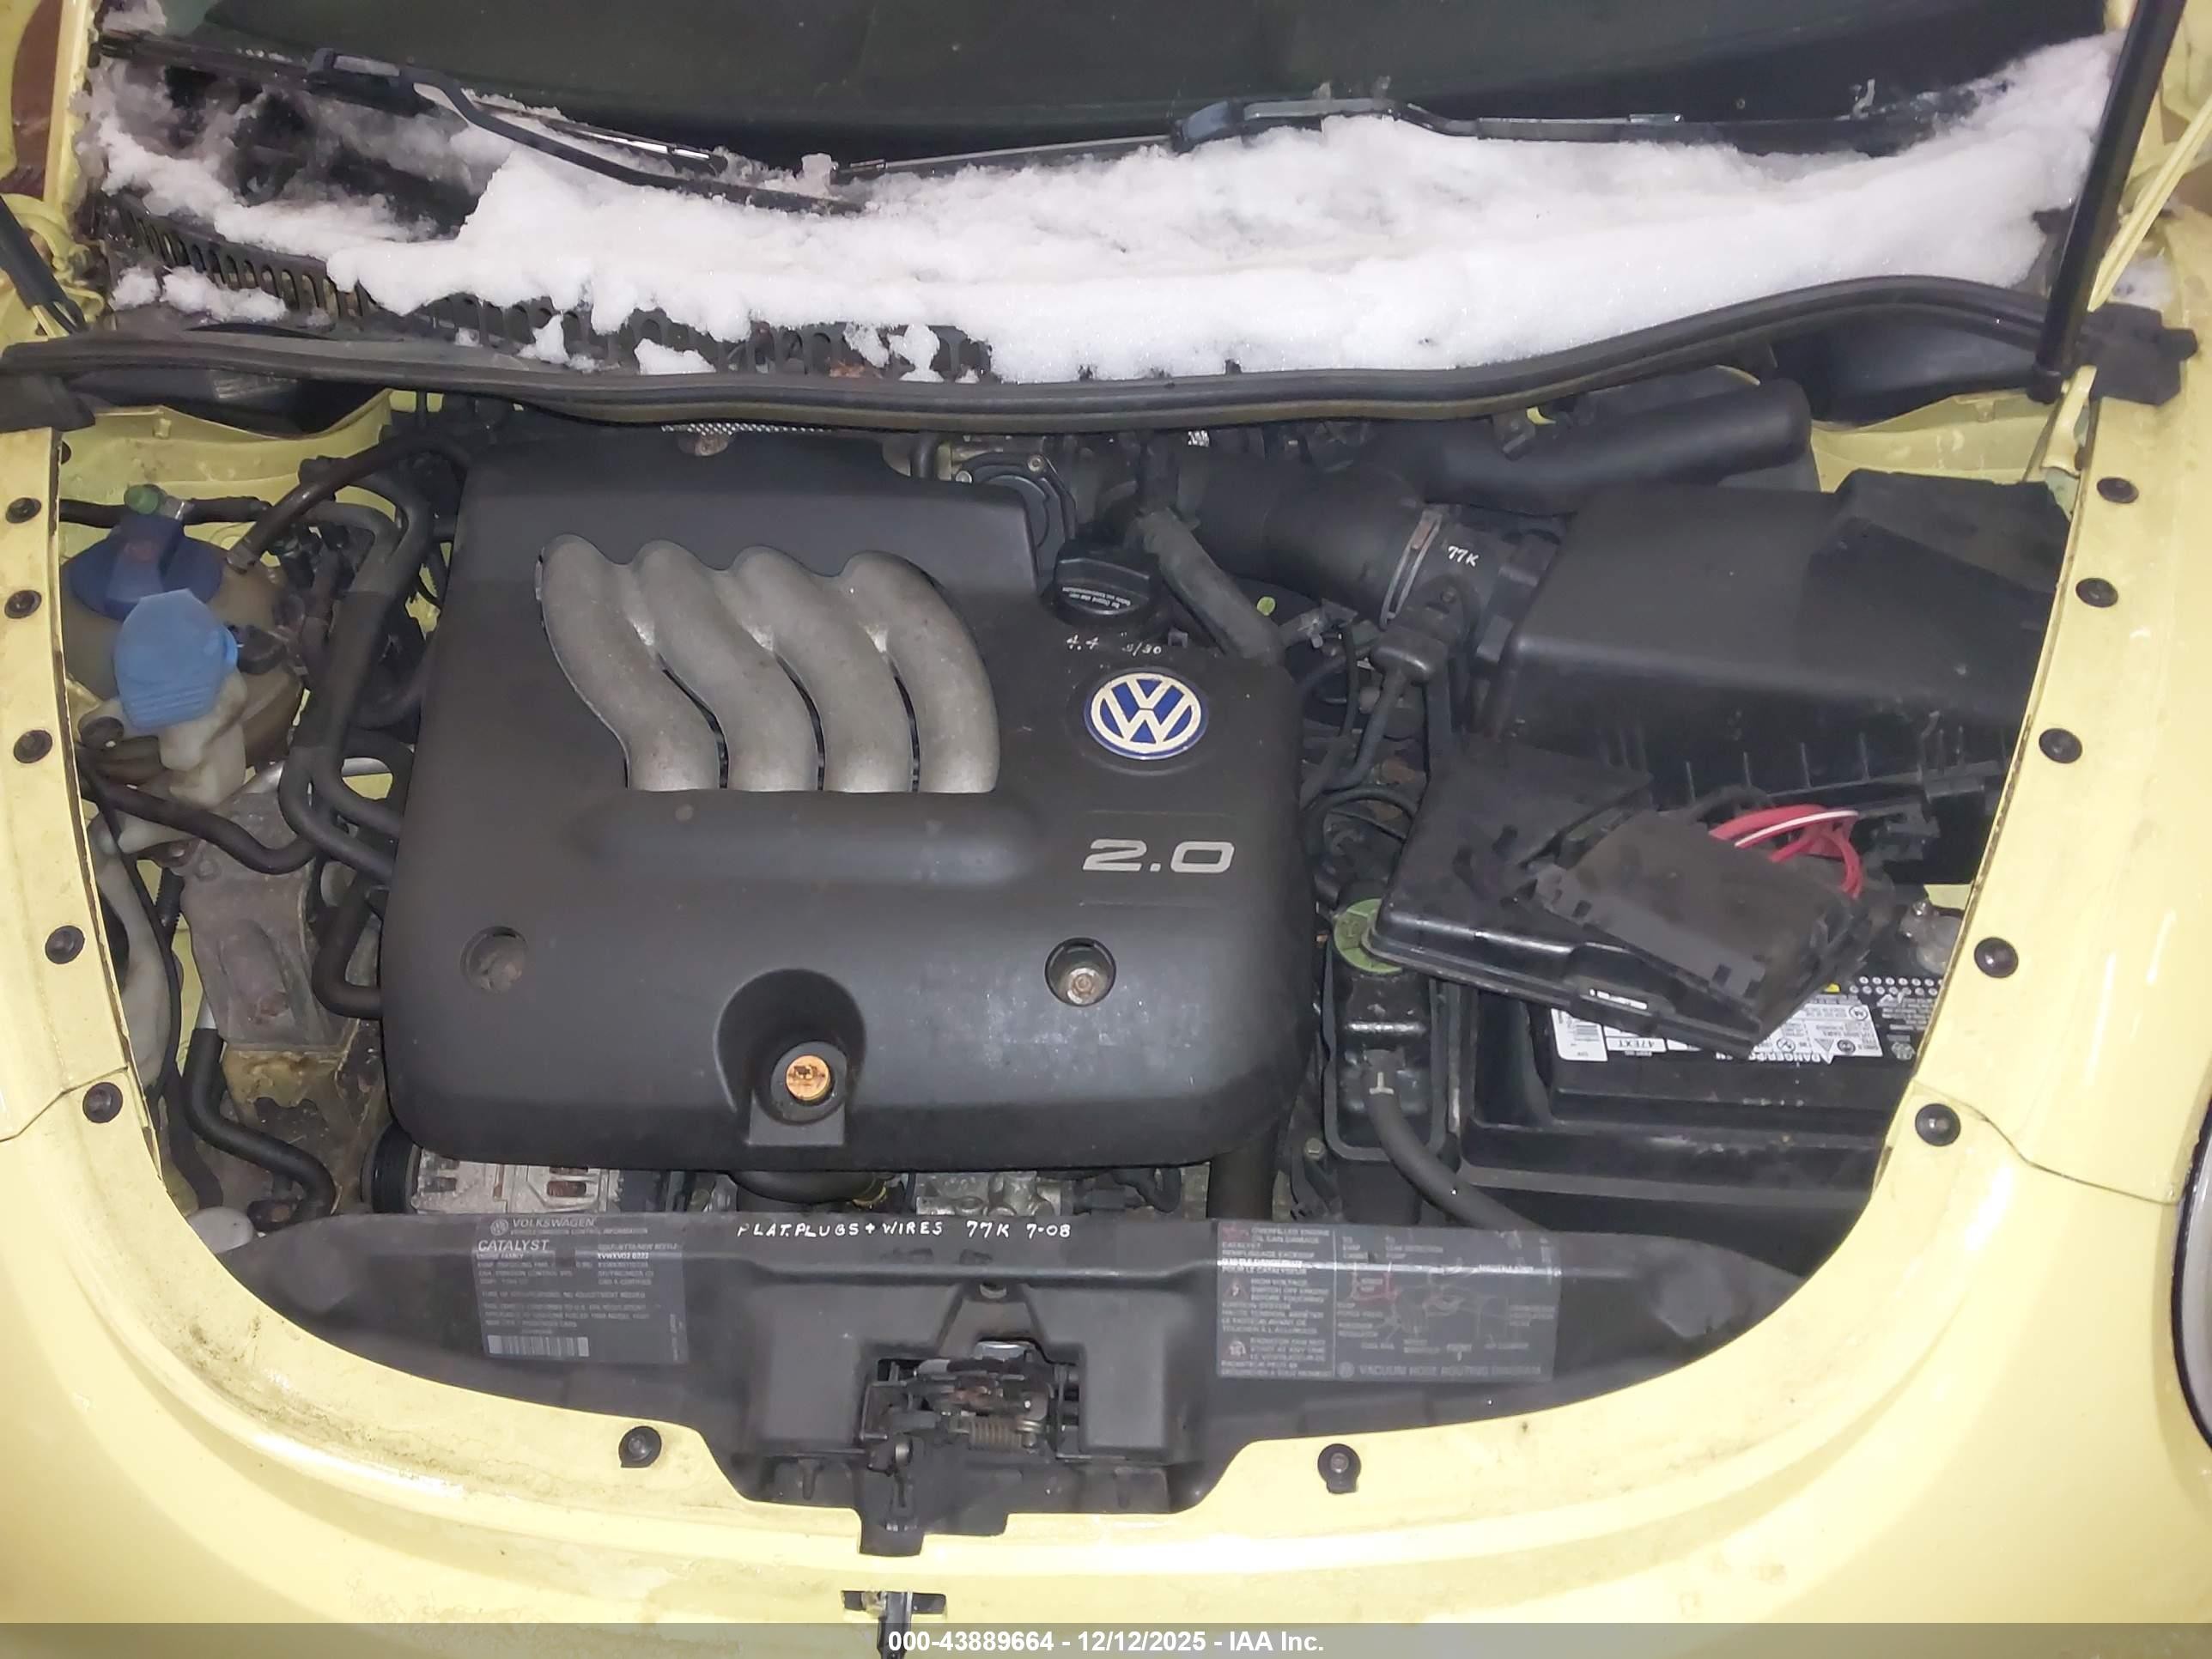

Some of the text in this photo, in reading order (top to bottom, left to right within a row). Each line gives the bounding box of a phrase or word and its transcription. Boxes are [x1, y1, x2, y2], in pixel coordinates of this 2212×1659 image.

[1448, 545, 1480, 568] 77K
[1082, 838, 1235, 873] 2.0
[513, 1218, 595, 1228] VOLKSWAGEN
[794, 1222, 860, 1237] PLUGS
[882, 1221, 943, 1236] WIRES
[966, 1220, 1010, 1238] 77K
[1026, 1223, 1072, 1239] 7-08
[478, 1238, 550, 1251] CATALYST
